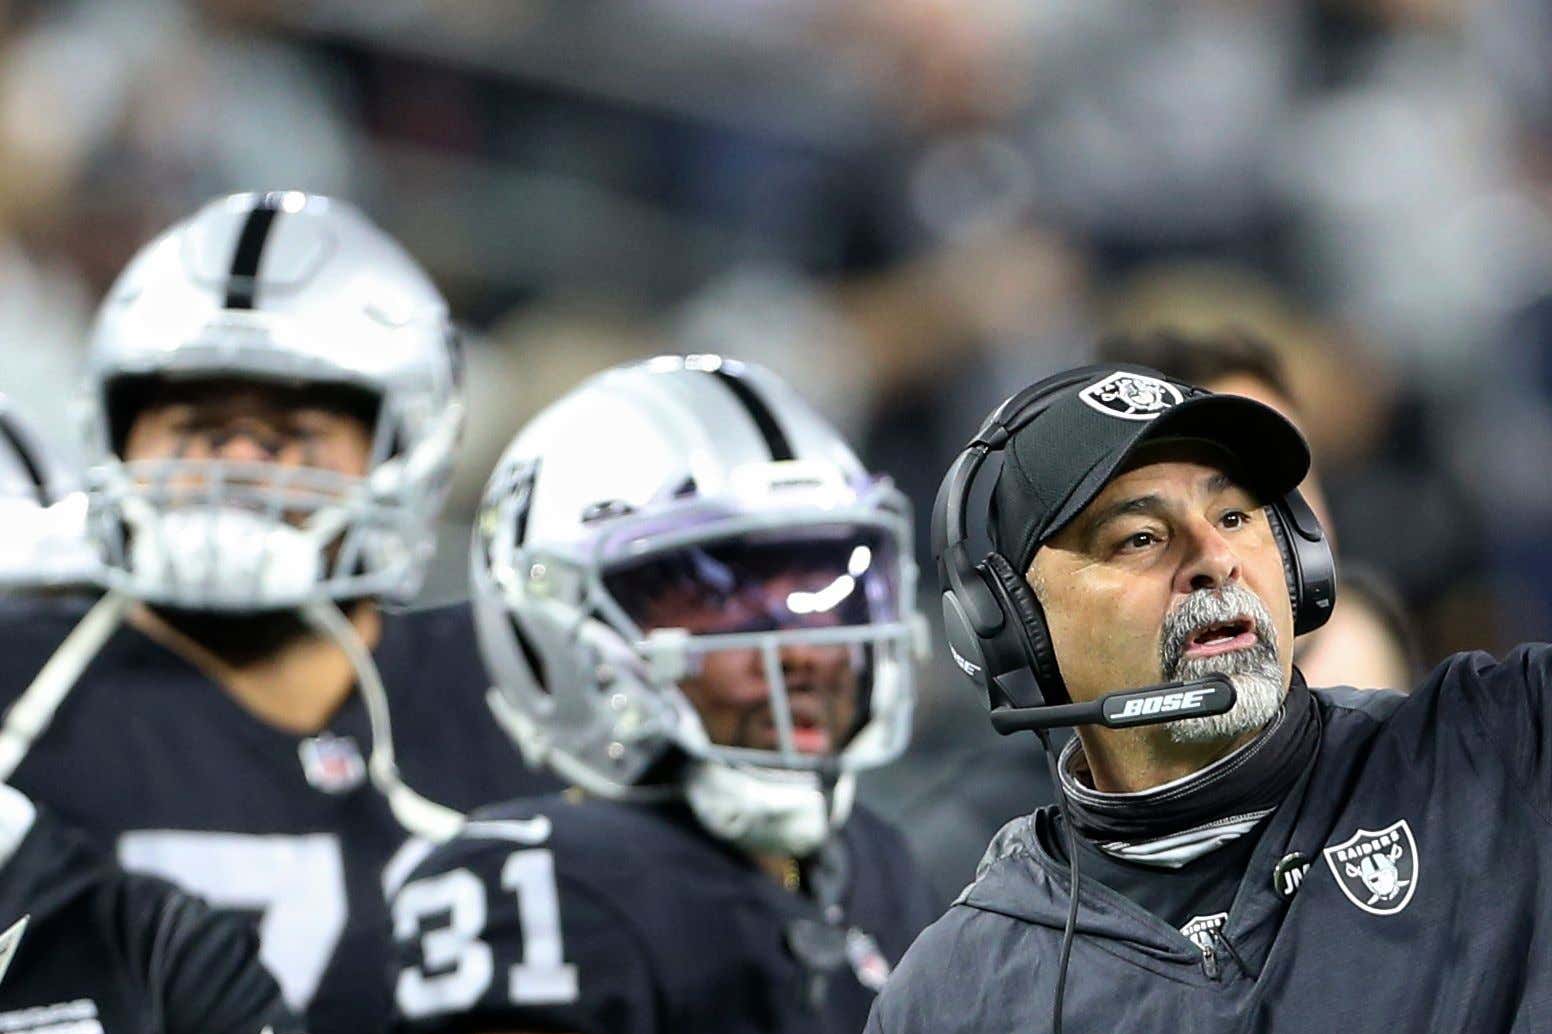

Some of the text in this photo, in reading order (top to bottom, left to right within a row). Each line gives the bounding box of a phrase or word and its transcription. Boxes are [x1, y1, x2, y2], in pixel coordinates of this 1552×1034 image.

[1110, 688, 1216, 719] BOSE
[1337, 830, 1400, 862] RAIDERS
[391, 847, 579, 1020] 31
